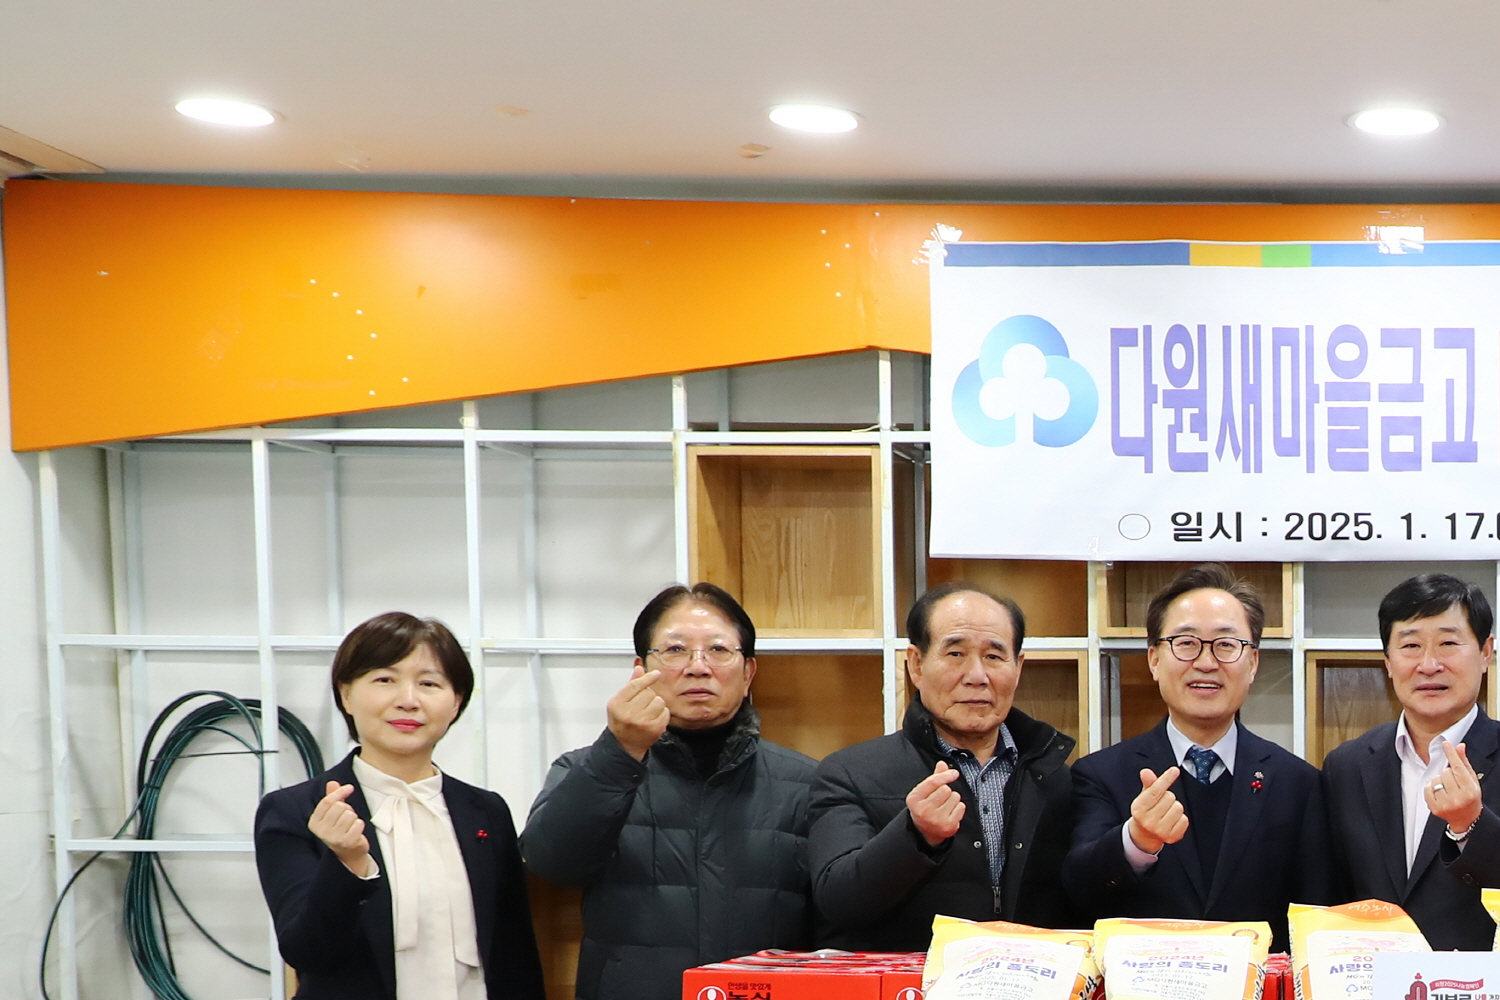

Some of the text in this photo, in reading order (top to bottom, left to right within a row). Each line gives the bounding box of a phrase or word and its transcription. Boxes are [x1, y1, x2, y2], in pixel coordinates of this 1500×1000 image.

[1108, 323, 1479, 474] 다원새마을금고
[1170, 511, 1242, 543] 일시
[1284, 512, 1382, 542] 2025.
[1400, 512, 1427, 541] 1.
